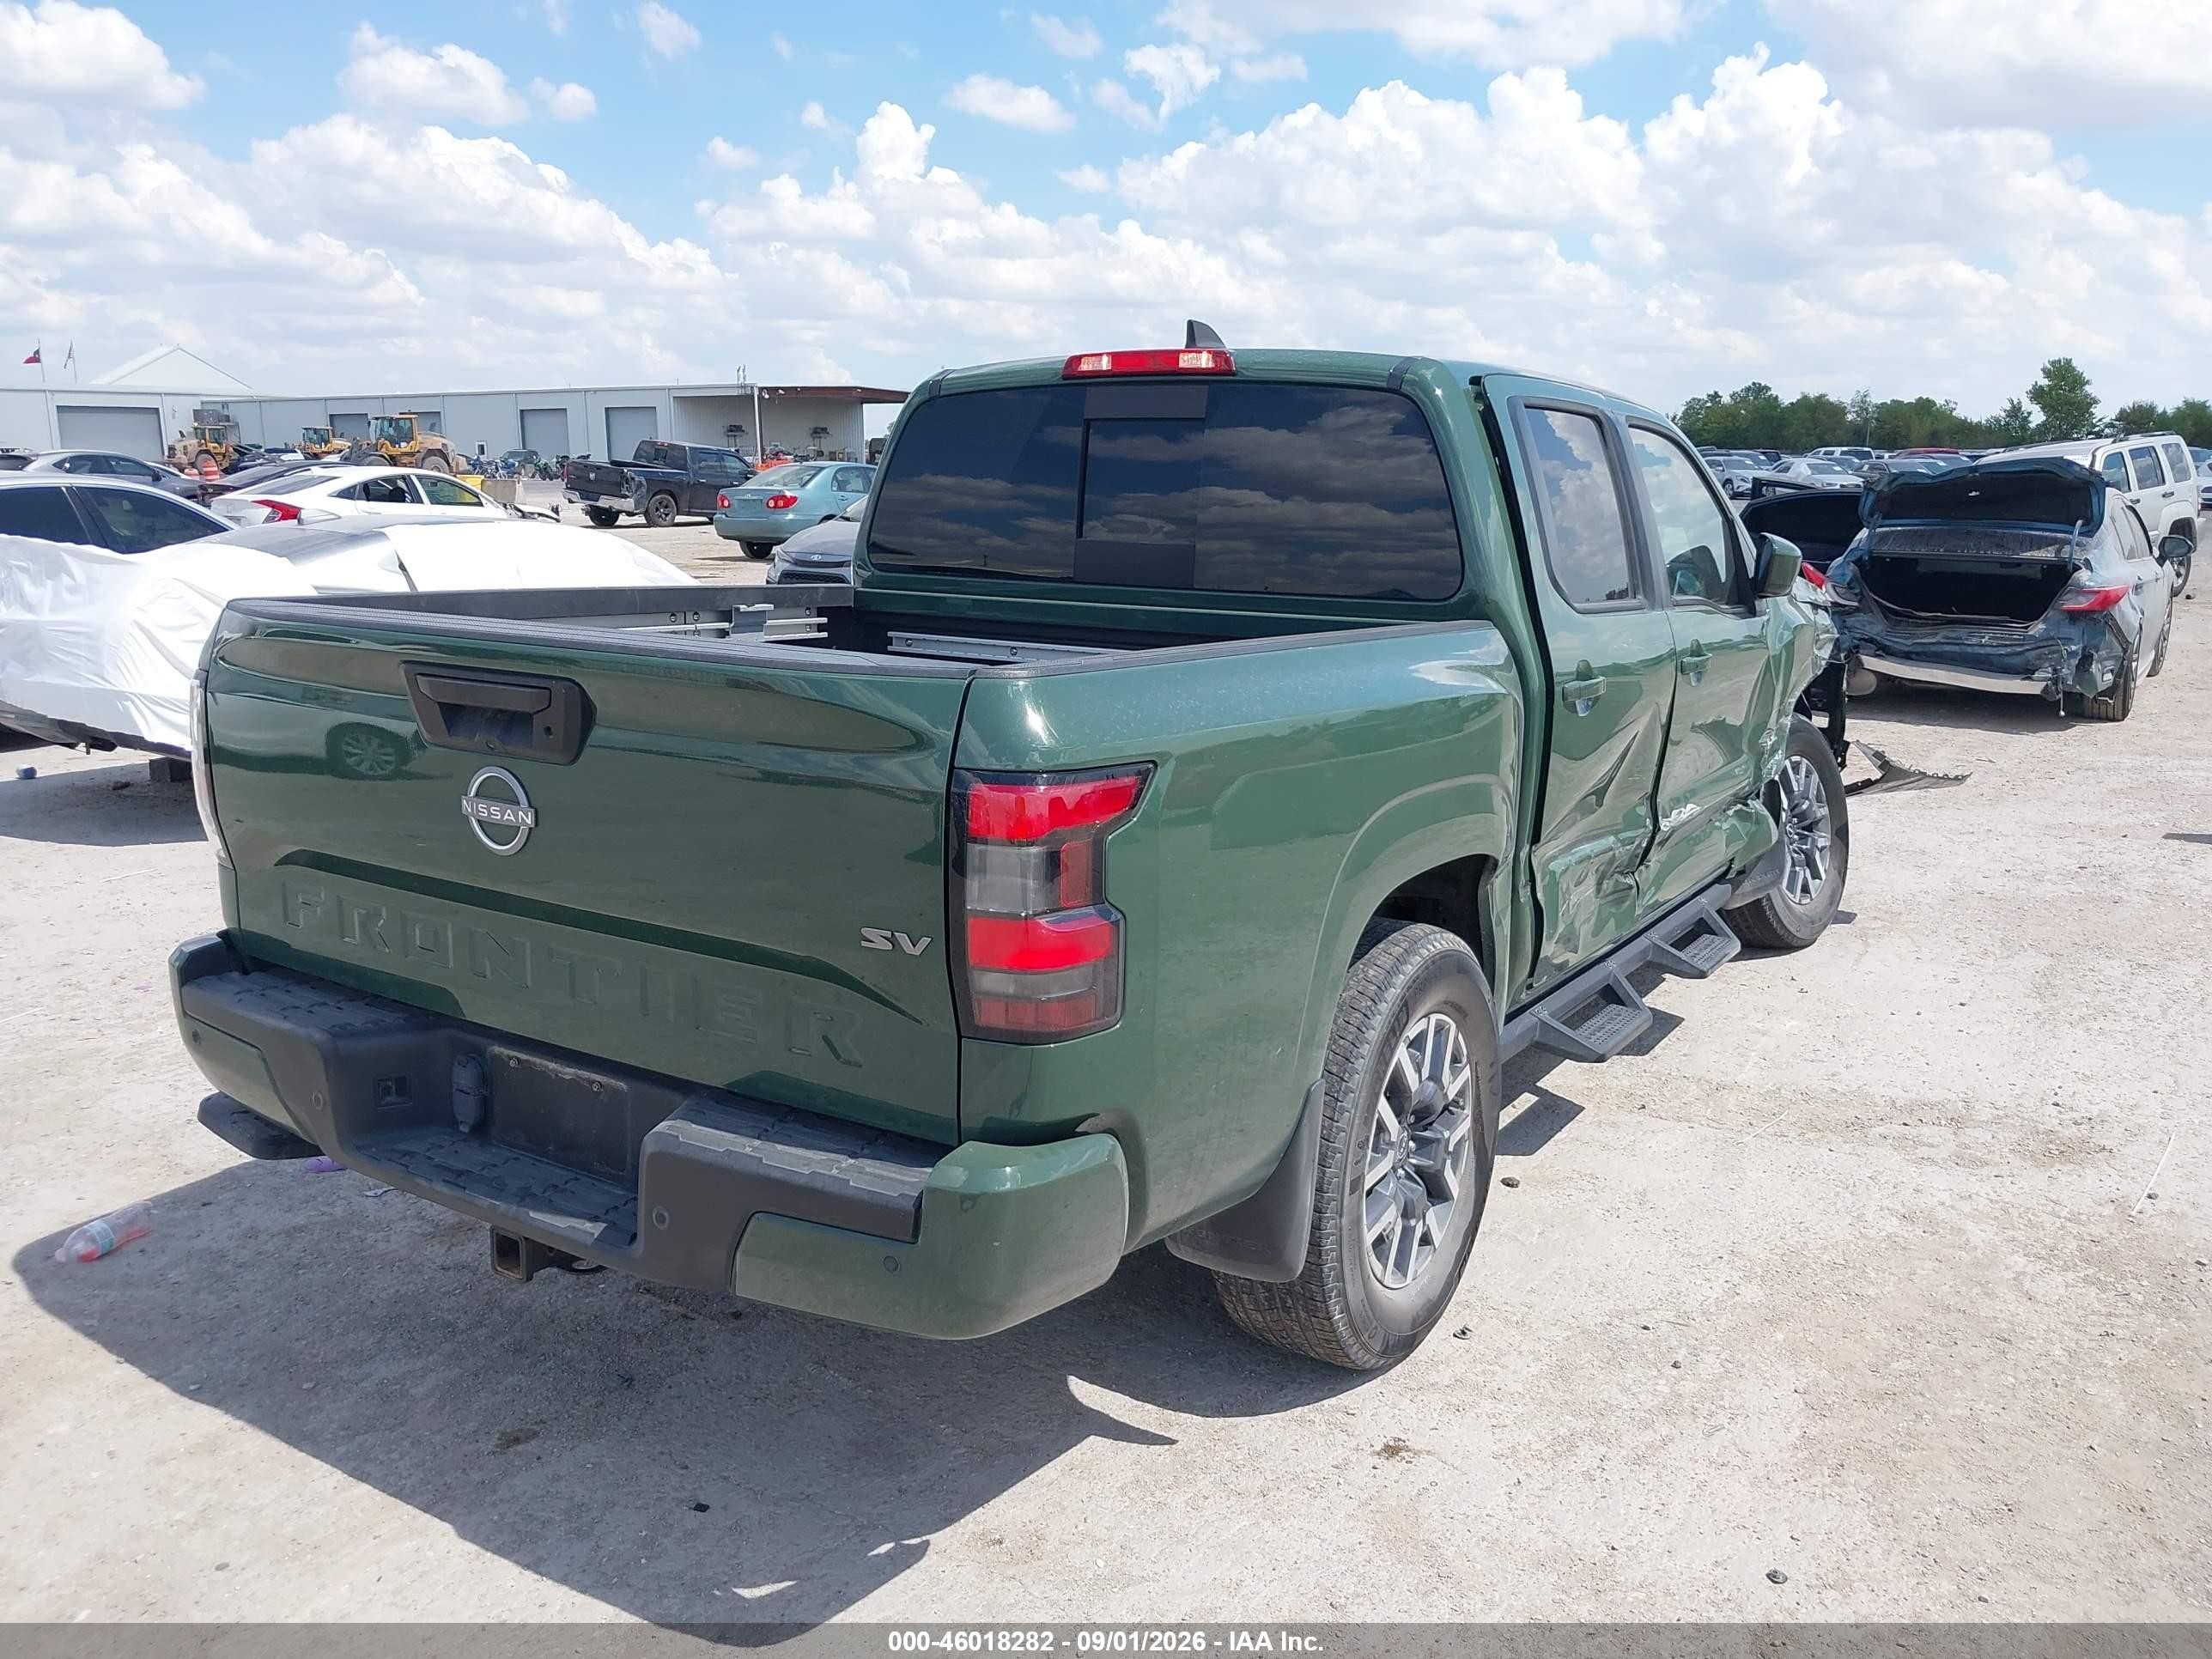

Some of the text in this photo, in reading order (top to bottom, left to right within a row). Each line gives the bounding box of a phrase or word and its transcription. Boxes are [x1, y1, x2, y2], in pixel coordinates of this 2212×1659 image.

[463, 799, 532, 825] NISSAN
[860, 927, 932, 956] SV
[281, 879, 864, 1067] FRONTIER
